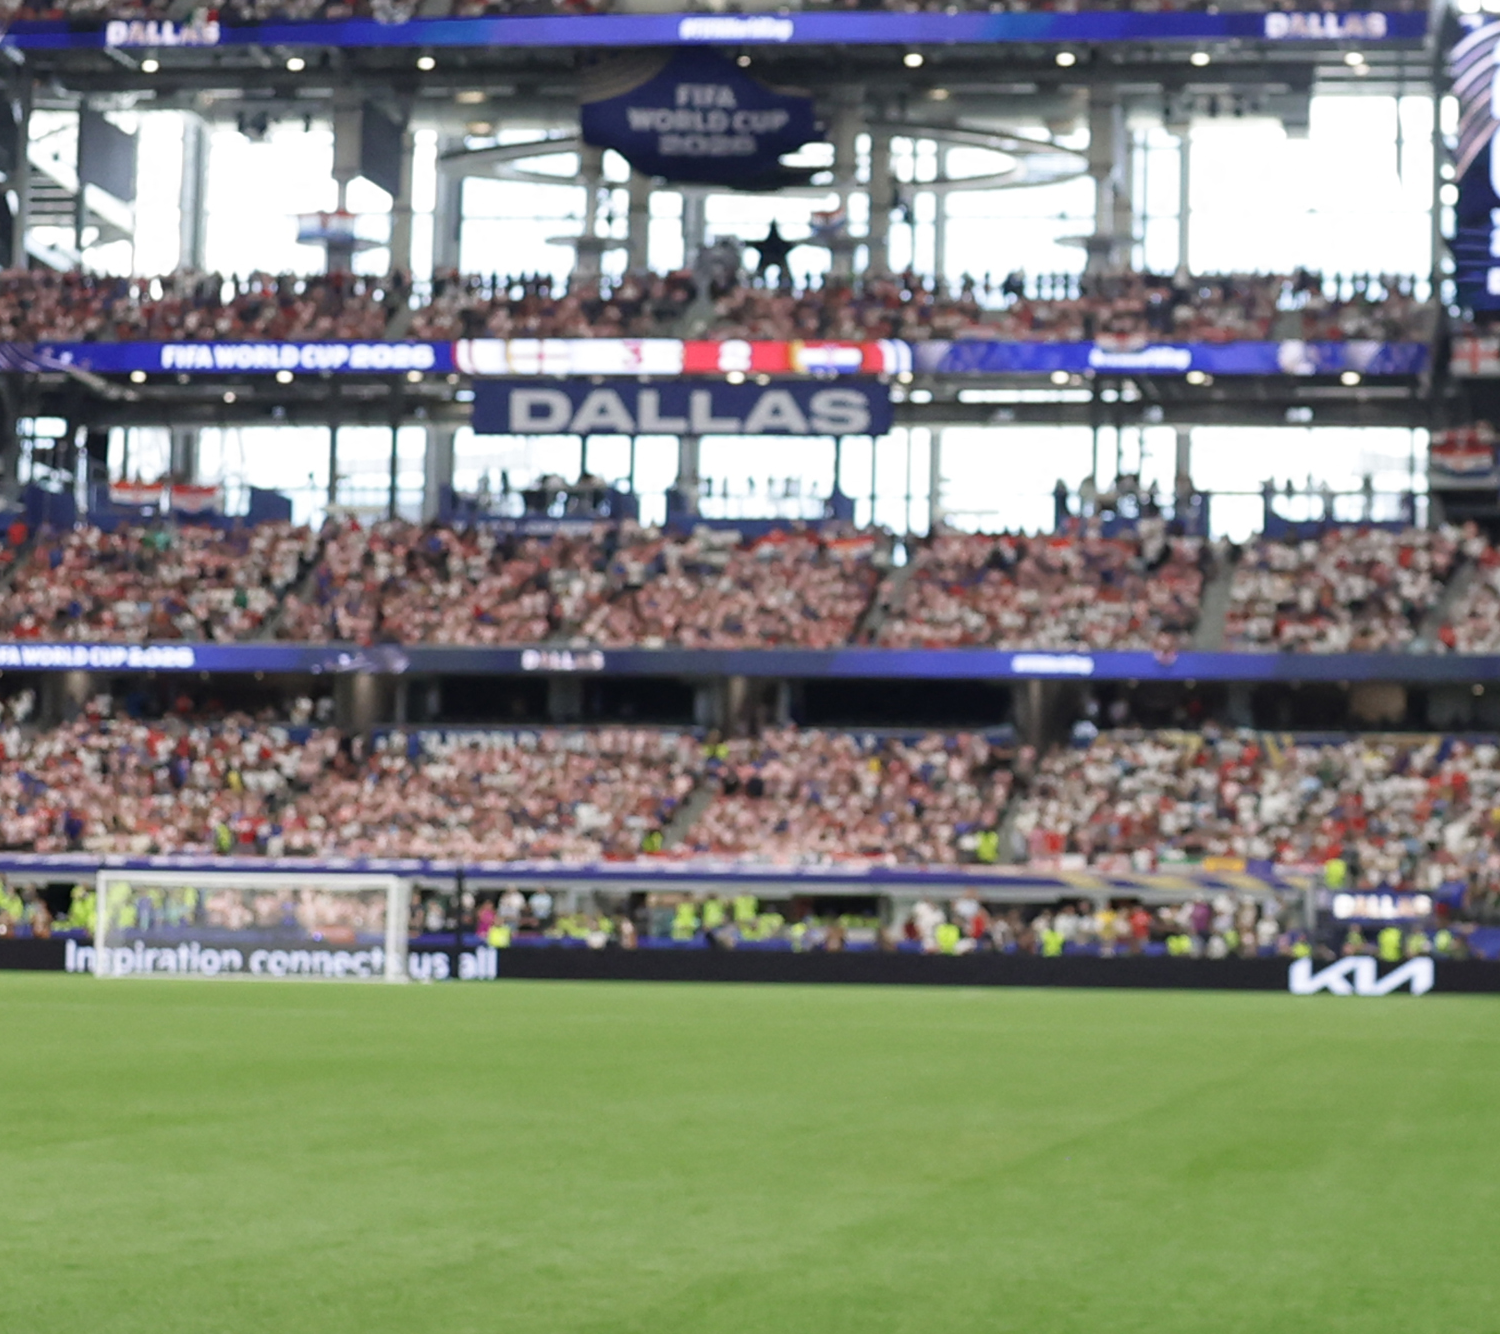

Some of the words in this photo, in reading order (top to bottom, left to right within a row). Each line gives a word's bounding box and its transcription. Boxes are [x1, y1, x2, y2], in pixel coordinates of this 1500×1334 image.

[105, 20, 220, 47] DALLAS
[1264, 11, 1387, 40] DALLAS
[674, 83, 737, 109] FIFA
[626, 107, 729, 133] WORLD
[731, 109, 790, 134] CUP
[160, 344, 212, 369] FIFA
[211, 344, 300, 369] WORLD
[300, 344, 350, 369] CUP
[349, 344, 436, 369] 2026
[508, 387, 873, 435] DALLAS
[64, 939, 242, 977] Inspiration
[407, 952, 450, 980] us
[457, 945, 499, 980] all
[1288, 954, 1435, 997] KIA
